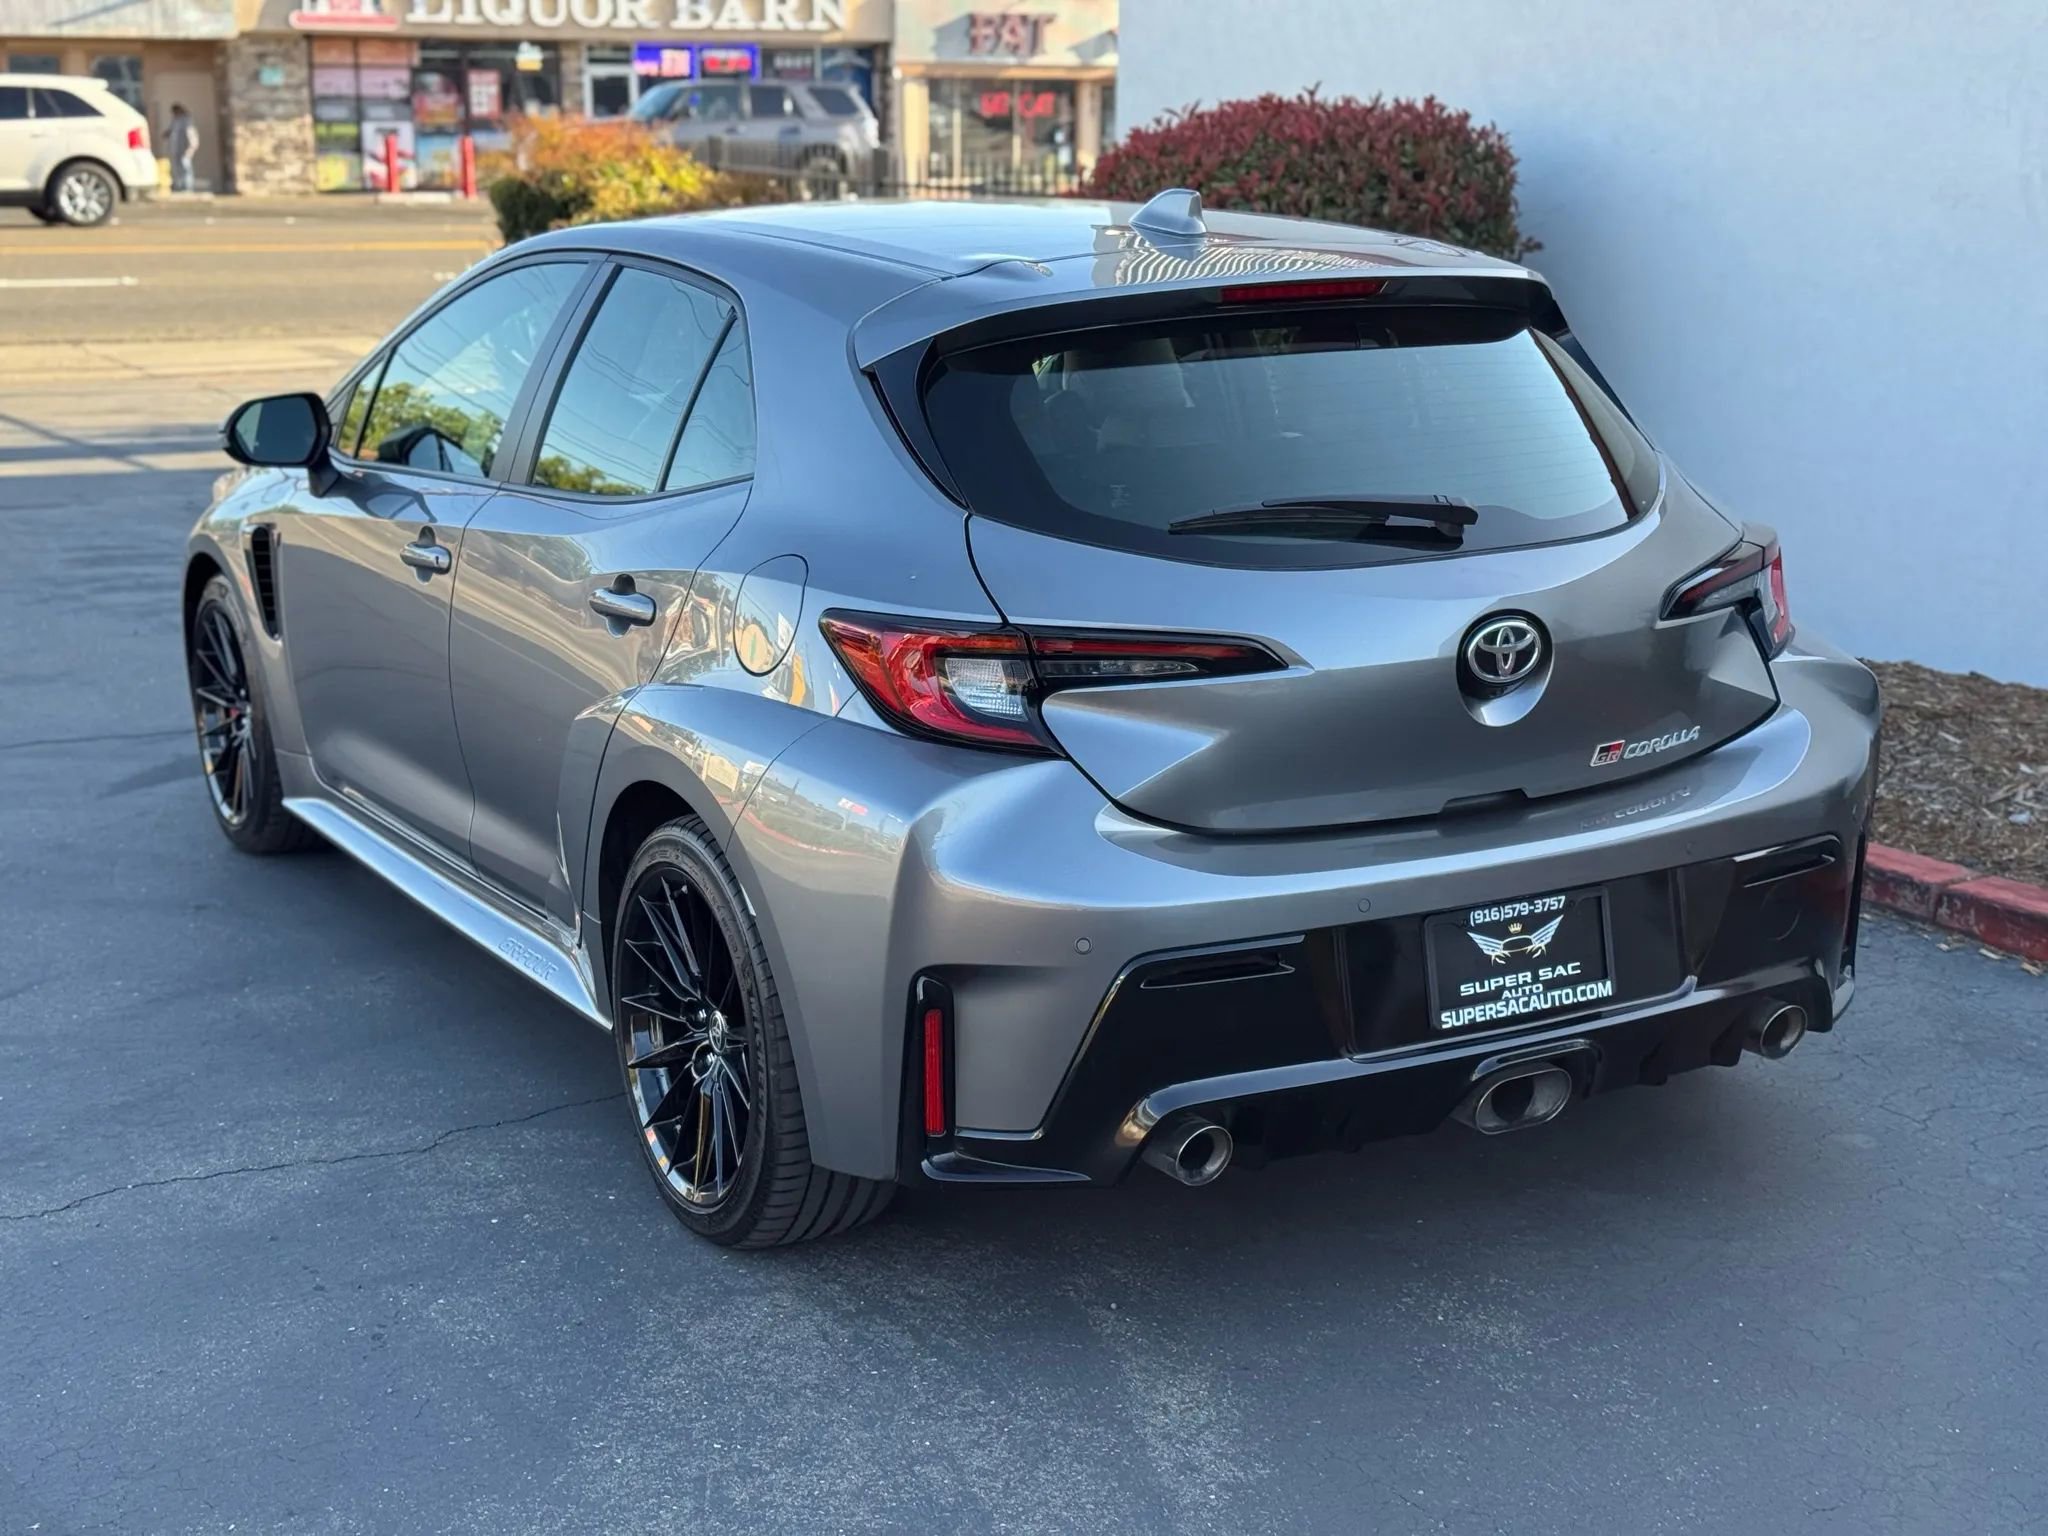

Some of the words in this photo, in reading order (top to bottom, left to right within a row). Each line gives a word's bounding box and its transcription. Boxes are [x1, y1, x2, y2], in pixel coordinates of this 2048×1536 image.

[405, 0, 658, 28] LIQUOR
[670, 0, 847, 30] BARN
[1623, 726, 1701, 760] COROLLA
[1469, 895, 1566, 927] (916)579-3757
[1460, 971, 1532, 996] SUPER
[1538, 961, 1582, 981] SAC
[1501, 983, 1544, 1000] AUTO
[1440, 980, 1613, 1029] SUPERSACAUTO.COM
